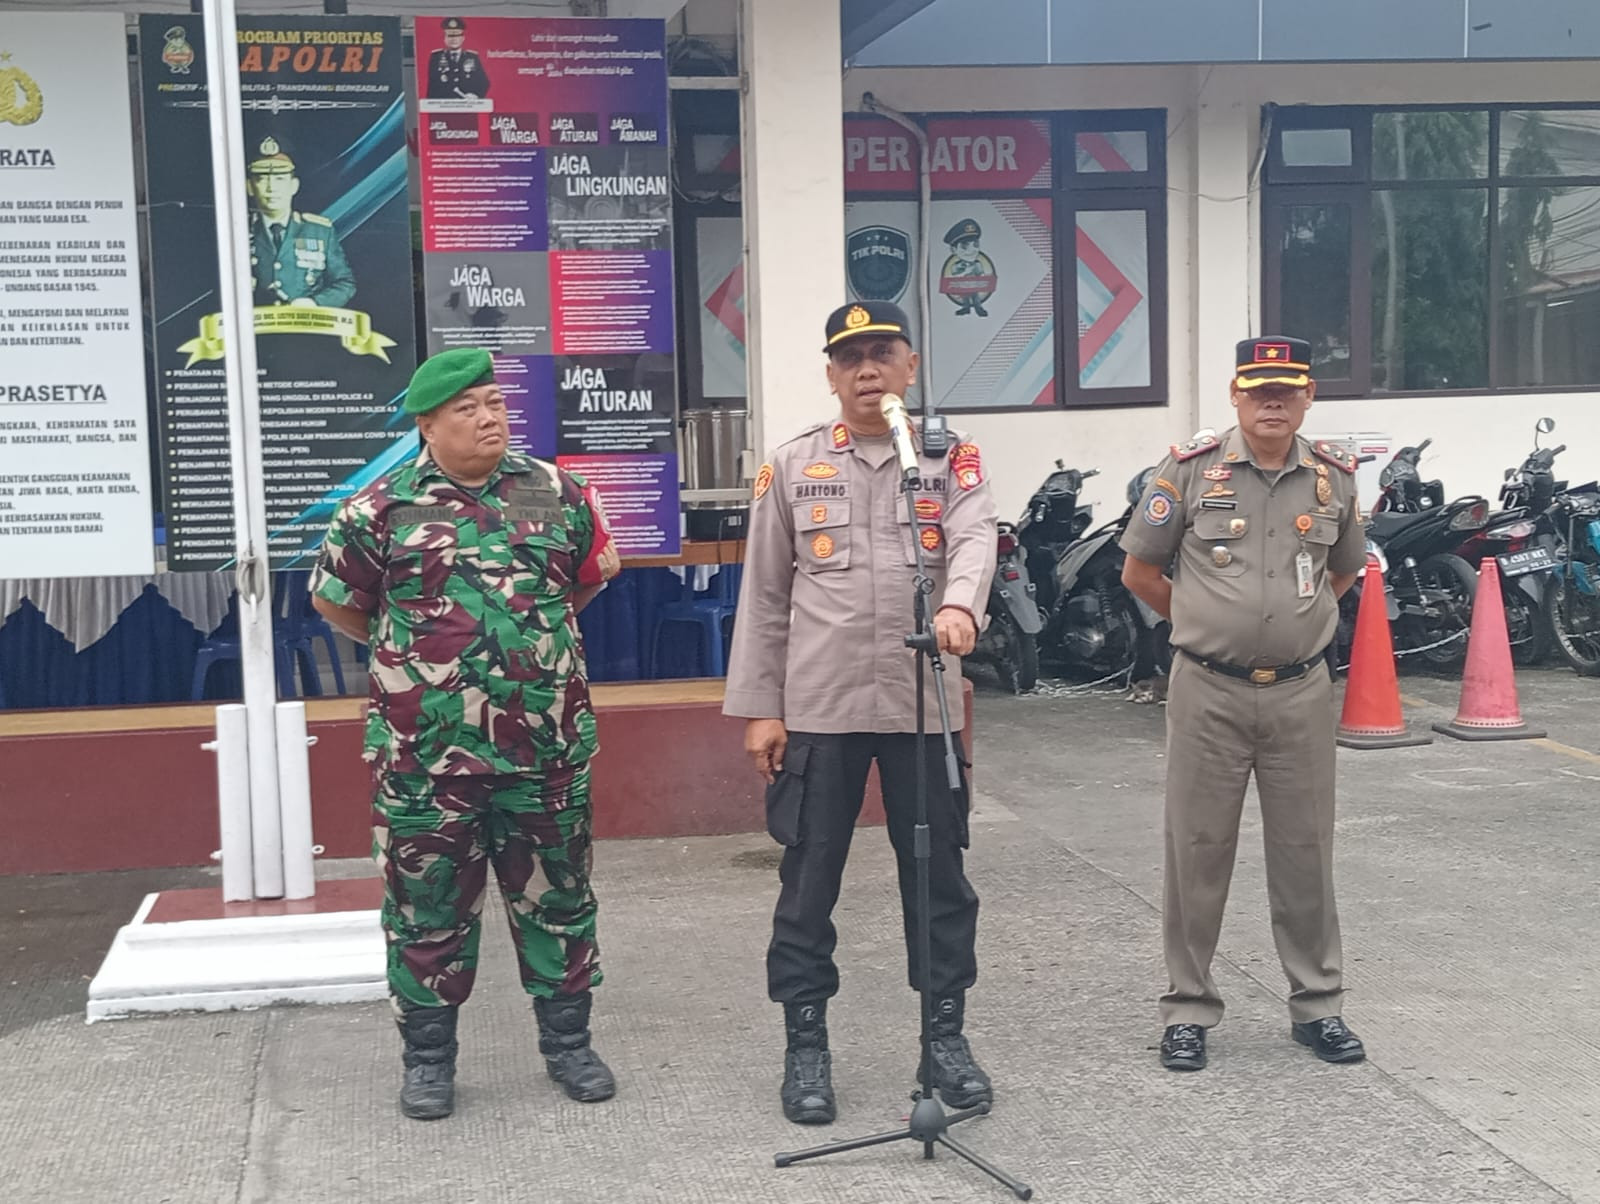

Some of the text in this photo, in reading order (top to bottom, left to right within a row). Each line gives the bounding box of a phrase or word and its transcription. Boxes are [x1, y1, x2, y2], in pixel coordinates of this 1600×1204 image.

[303, 31, 384, 44] PRIORITAS
[241, 45, 384, 73] APOLRI
[490, 117, 518, 132] JAGA
[551, 118, 574, 131] JAGA
[610, 118, 634, 131] JAGA
[501, 130, 539, 144] WARGA
[559, 130, 598, 143] ATURAN
[619, 130, 657, 142] AMANAH
[0, 149, 55, 166] RATA
[550, 153, 591, 176] JAGA
[566, 176, 667, 197] LINGKUNGAN
[56, 200, 92, 210] DENGAN
[18, 215, 42, 224] YANG
[106, 240, 126, 250] DAN
[55, 254, 88, 263] HUKUM
[92, 254, 127, 262] NEGARA
[36, 269, 60, 278] YANG
[64, 268, 128, 278] BERDASARKAN
[450, 264, 492, 286] JAGA
[44, 283, 72, 292] DASAR
[466, 286, 526, 308] WARGA
[8, 308, 63, 318] MENGAYOMI
[64, 308, 84, 316] DAN
[85, 308, 130, 316] MELAYANI
[96, 322, 130, 331] UNTUK
[10, 337, 29, 346] DAN
[561, 365, 607, 390] JAGA
[579, 390, 653, 413] ATURAN
[46, 420, 108, 430] KEHORMATAN
[114, 420, 136, 429] SAYA
[119, 433, 138, 442] DAN
[31, 474, 80, 483] GANGGUAN
[81, 472, 130, 482] KEAMANAN
[18, 487, 42, 496] JIWA
[76, 486, 104, 494] HARTA
[796, 484, 846, 498] HARTONO
[5, 513, 68, 522] BERDASARKAN
[54, 526, 73, 534] DAN
[74, 524, 104, 534] DAMAI
